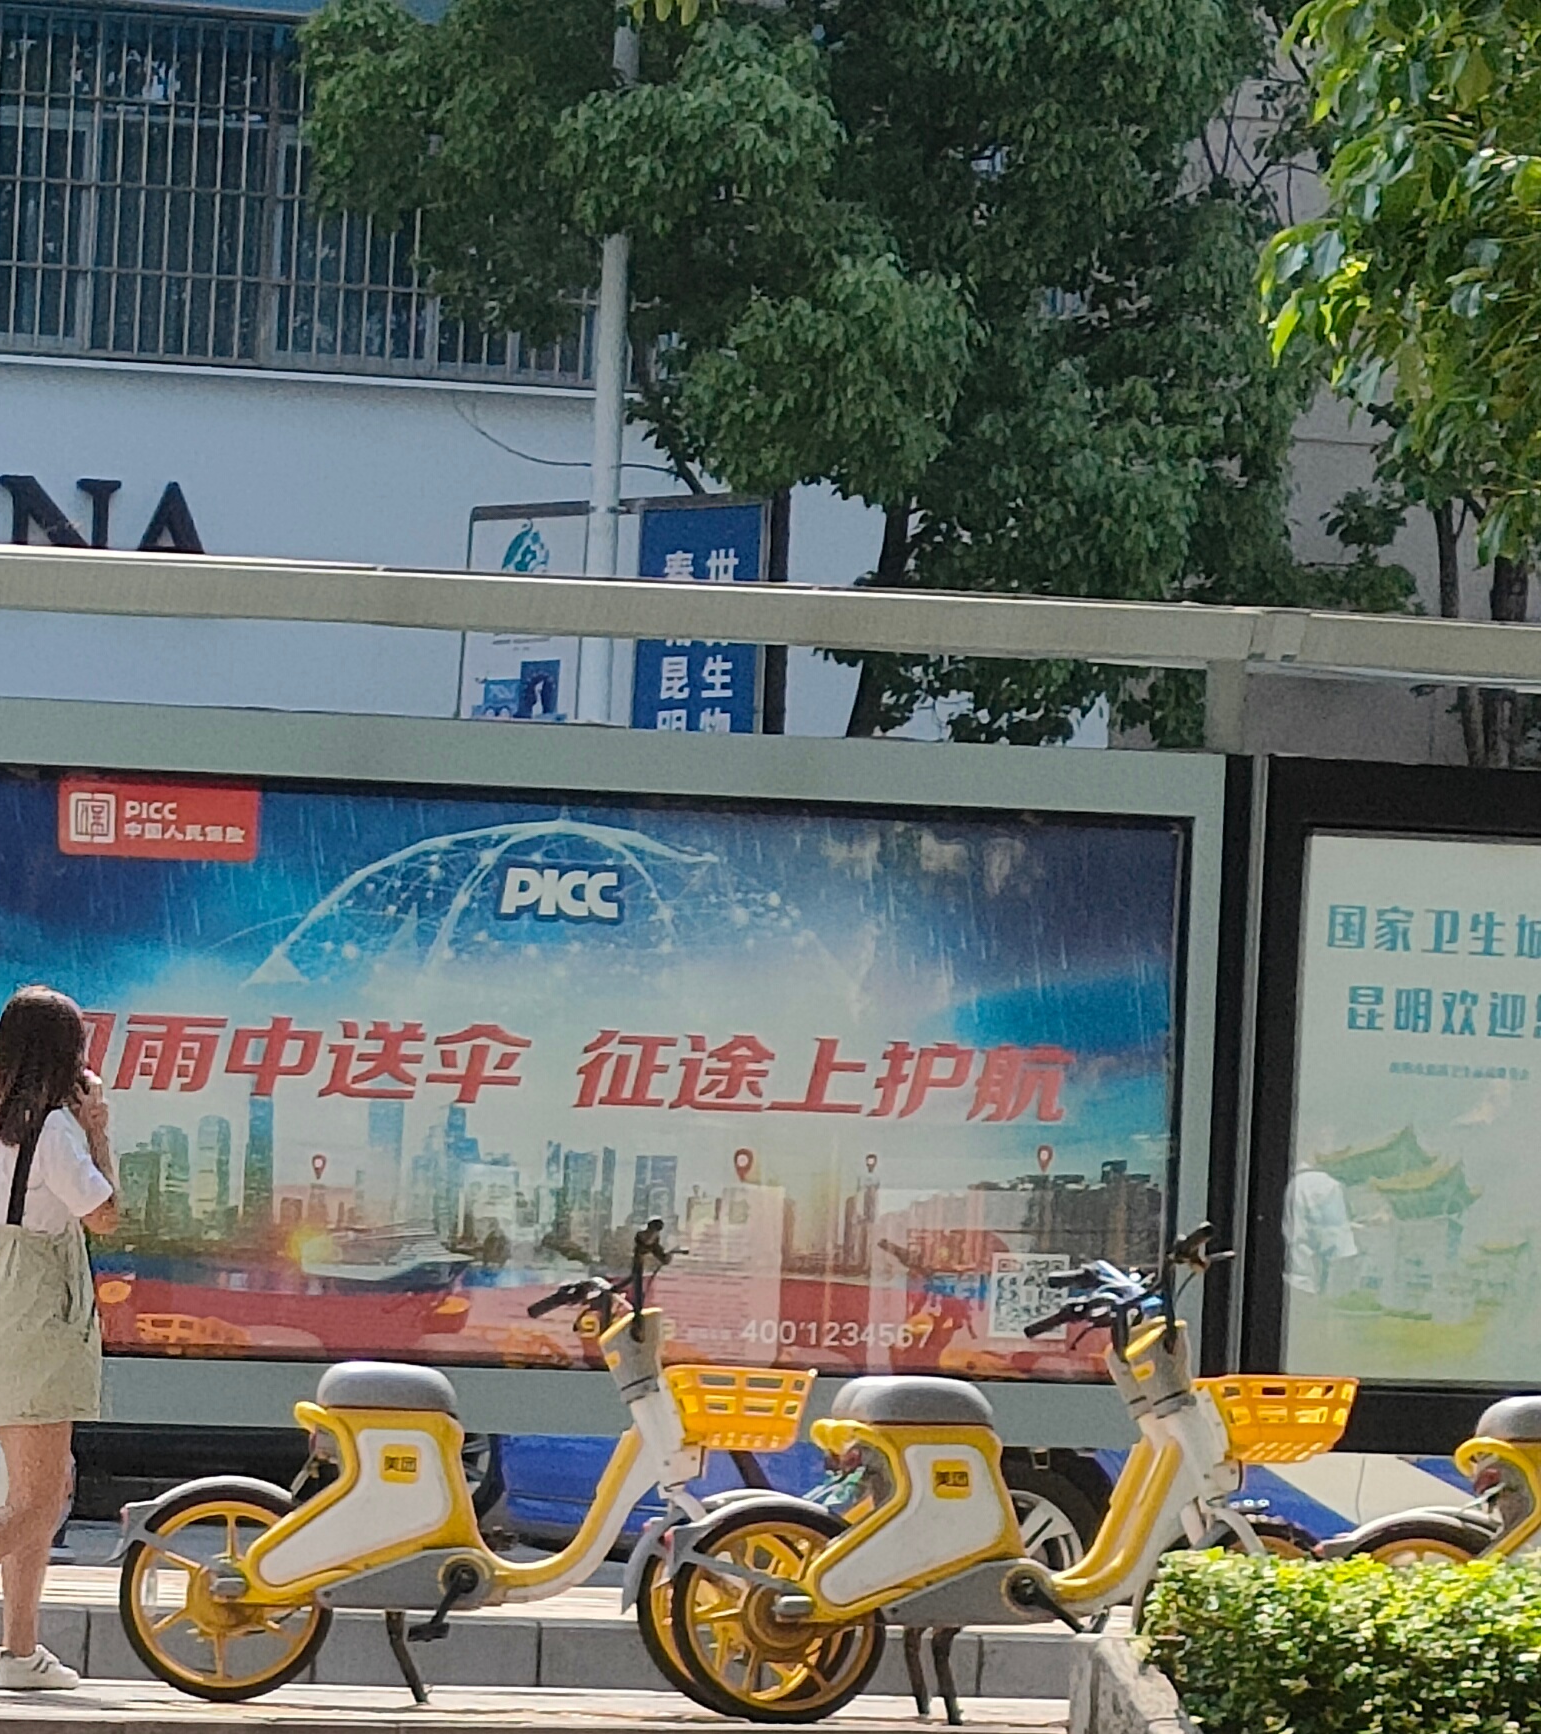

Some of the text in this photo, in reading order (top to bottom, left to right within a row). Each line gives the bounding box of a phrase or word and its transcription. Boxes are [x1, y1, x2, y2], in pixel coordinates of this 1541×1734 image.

[123, 821, 246, 843] 中国人民保险
[124, 800, 178, 820] PICC
[500, 866, 619, 919] PICC
[1346, 984, 1541, 1039] 昆明欢迎
[572, 1028, 1076, 1123] 征途上护航
